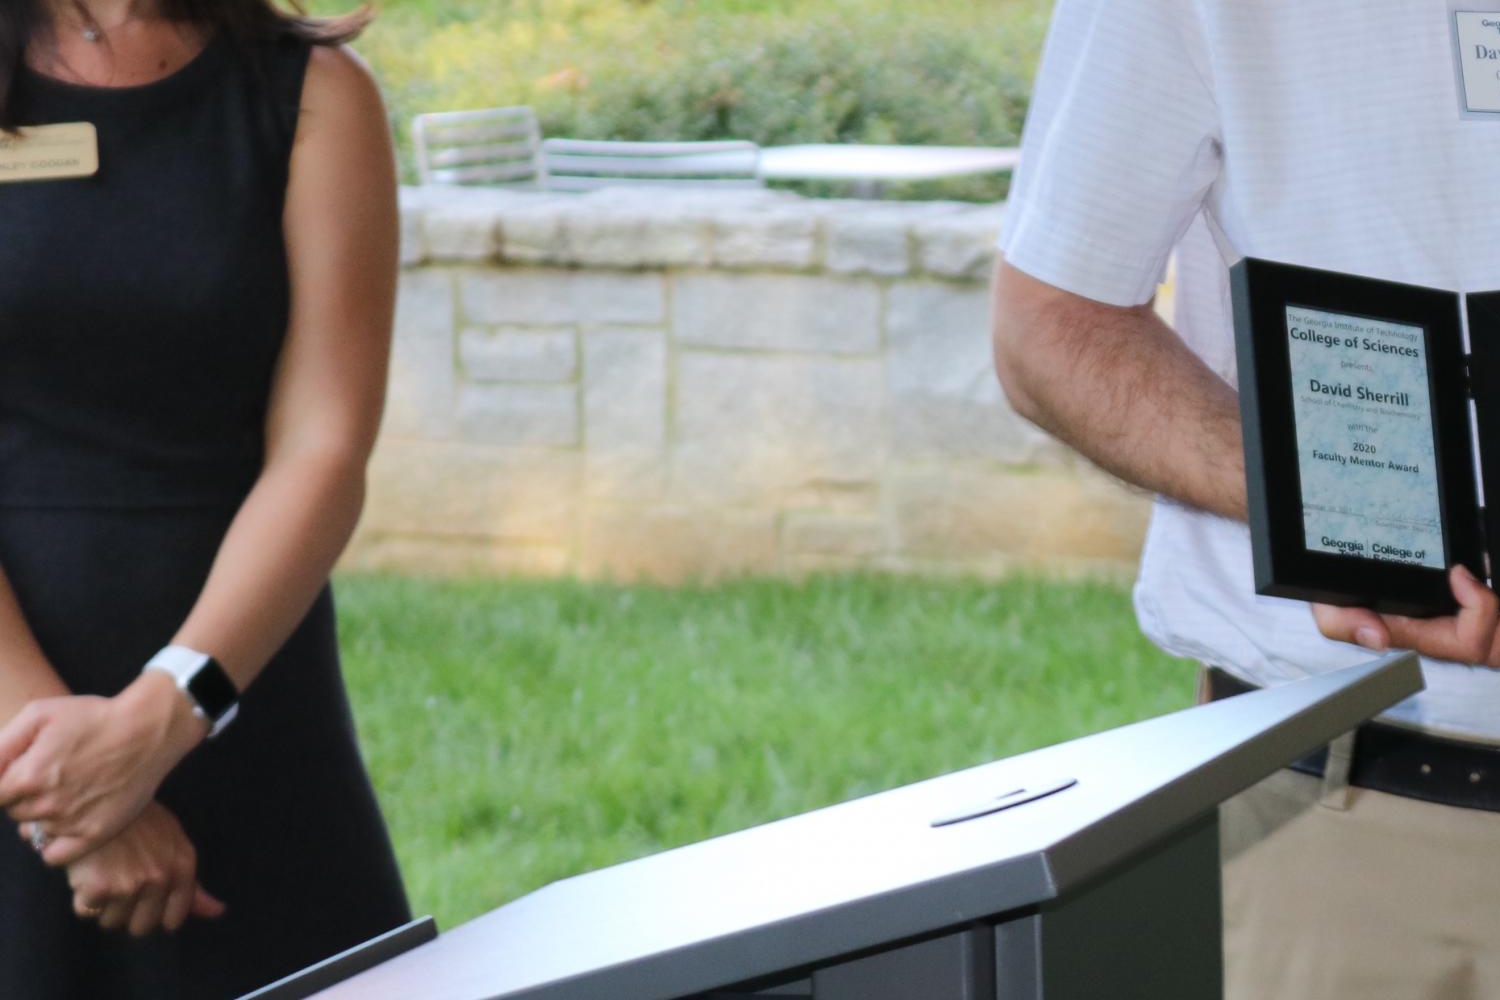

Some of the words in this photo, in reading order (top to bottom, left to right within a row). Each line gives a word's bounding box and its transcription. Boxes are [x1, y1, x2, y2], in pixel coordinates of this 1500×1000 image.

[1288, 313, 1301, 322] The
[1303, 316, 1333, 329] Georgia
[1334, 321, 1364, 333] Institute
[1366, 326, 1374, 334] of
[1376, 328, 1418, 343] Technology
[1290, 327, 1341, 348] College
[1344, 336, 1359, 348] of
[1363, 338, 1419, 358] Sciences
[1310, 379, 1352, 398] David
[1356, 386, 1409, 407] Sherrill
[1353, 442, 1376, 454] 2020
[1312, 450, 1347, 465] Faculty
[1349, 456, 1385, 469] Mentor
[1388, 460, 1419, 473] Award
[1321, 536, 1364, 551] Georgia
[1372, 543, 1412, 559] College
[1415, 550, 1426, 559] of
